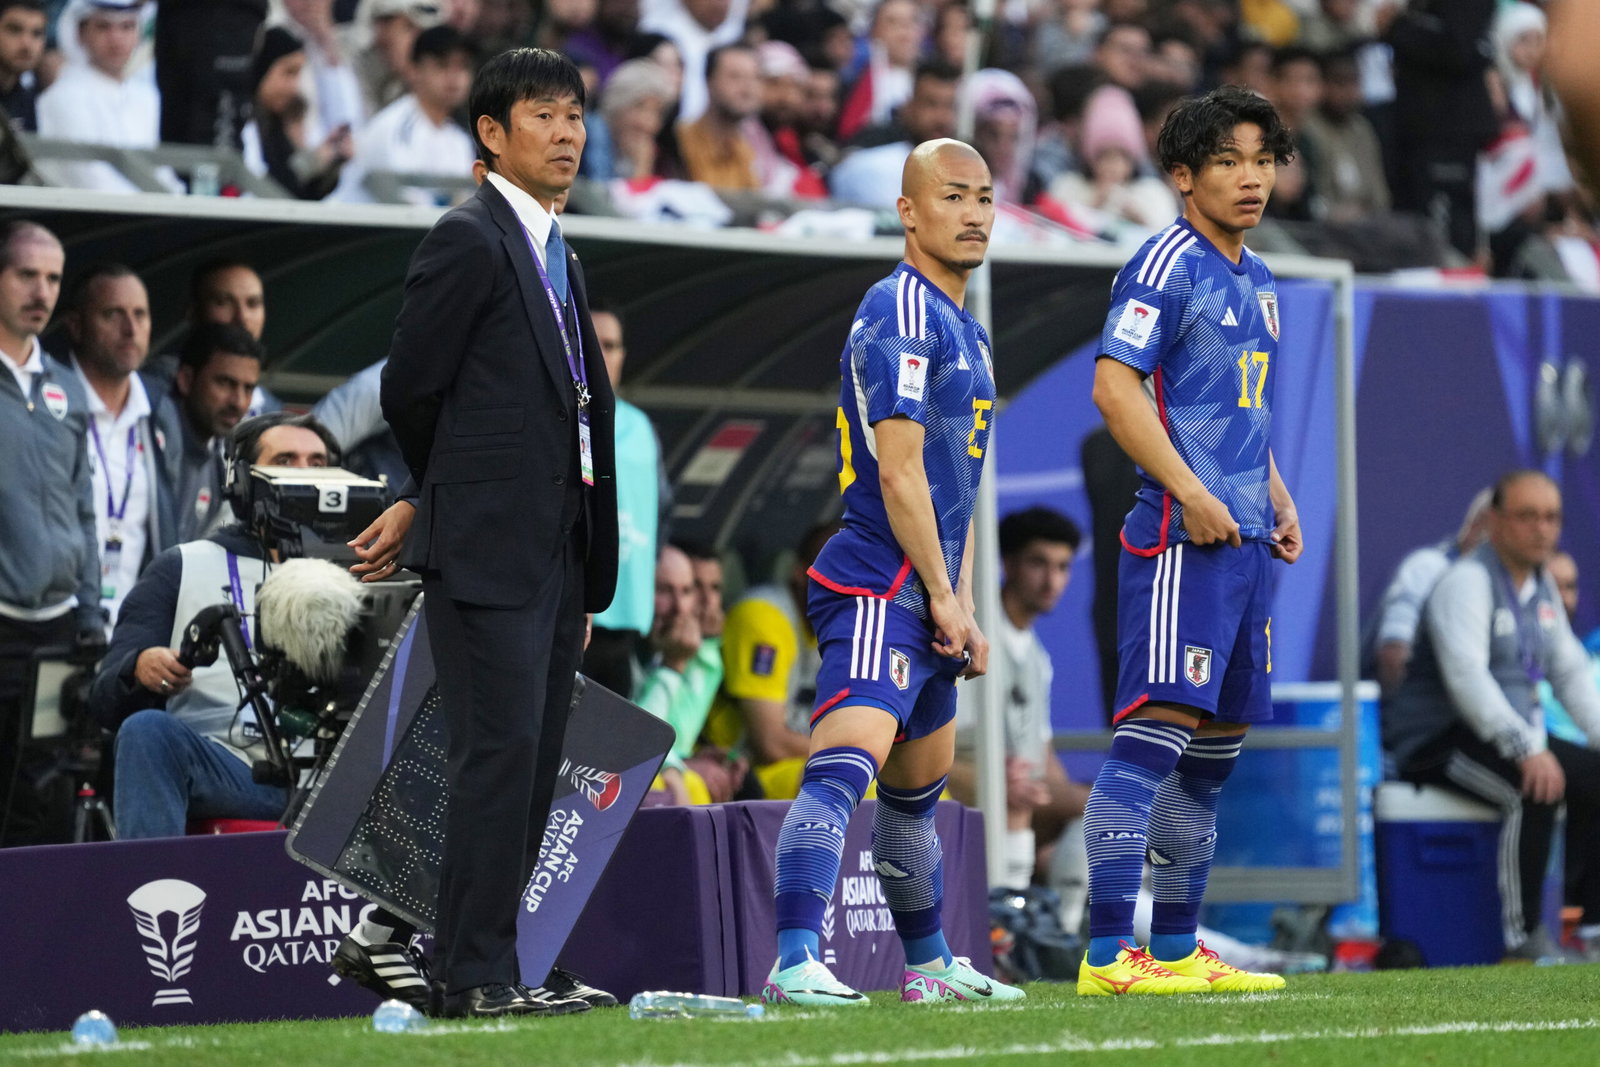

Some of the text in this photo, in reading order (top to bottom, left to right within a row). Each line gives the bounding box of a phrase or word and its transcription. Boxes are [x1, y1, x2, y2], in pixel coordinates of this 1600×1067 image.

[1237, 351, 1269, 408] 17
[325, 491, 342, 508] 3
[543, 809, 585, 873] ASIAN
[797, 822, 845, 838] JAP
[557, 852, 579, 884] AFC
[525, 871, 553, 913] CUP
[841, 876, 876, 906] ASIAN
[230, 905, 350, 941] ASIAN
[846, 908, 897, 938] QATAR 202
